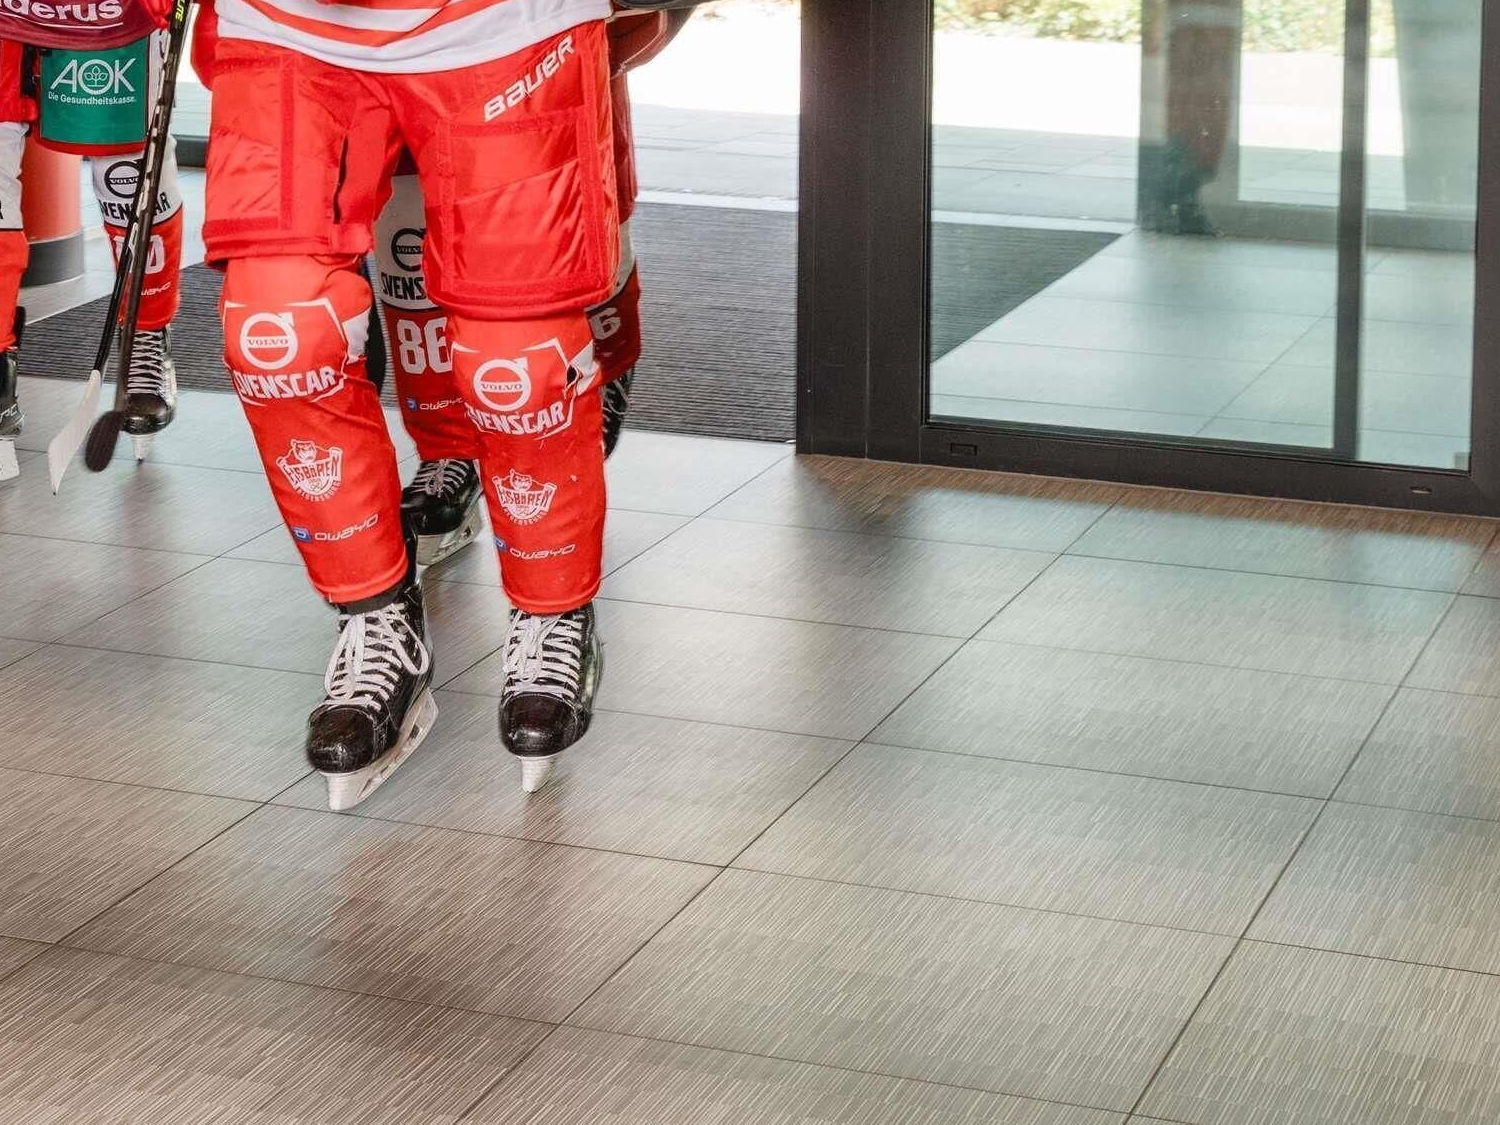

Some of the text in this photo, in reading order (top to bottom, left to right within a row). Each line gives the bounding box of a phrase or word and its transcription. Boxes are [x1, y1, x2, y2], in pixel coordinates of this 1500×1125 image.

[49, 57, 137, 96] AOK
[483, 34, 574, 124] BAUER
[247, 338, 289, 347] VOLVO
[481, 383, 523, 392] VOLVO
[314, 514, 379, 541] owayo
[509, 543, 576, 560] owayo
